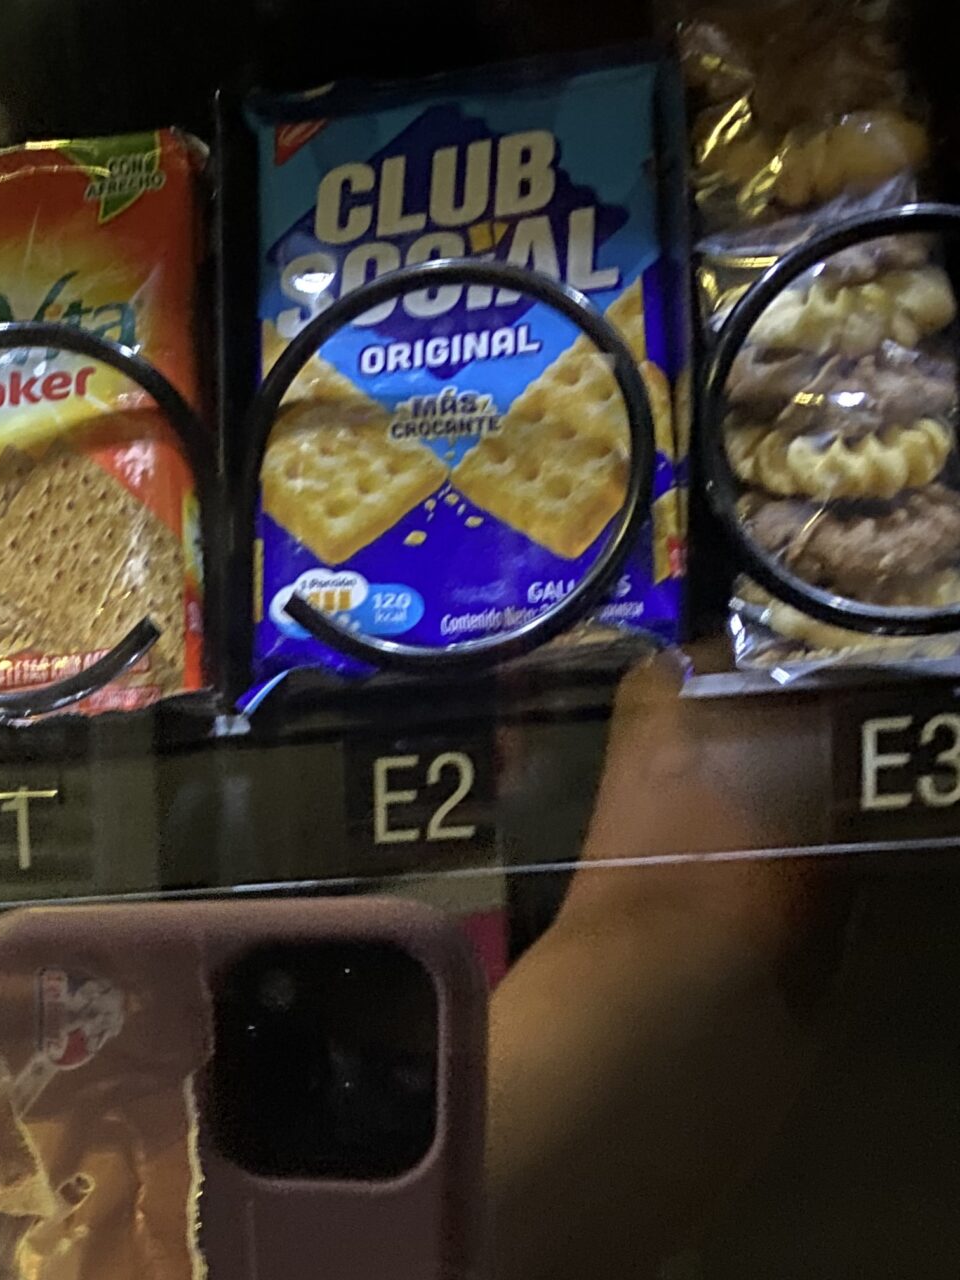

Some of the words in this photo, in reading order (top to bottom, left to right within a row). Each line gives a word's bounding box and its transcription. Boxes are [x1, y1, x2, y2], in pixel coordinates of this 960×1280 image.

[314, 130, 556, 245] CLUB
[361, 325, 541, 374] ORIGINAL
[373, 752, 476, 845] E2
[860, 713, 960, 812] E3
